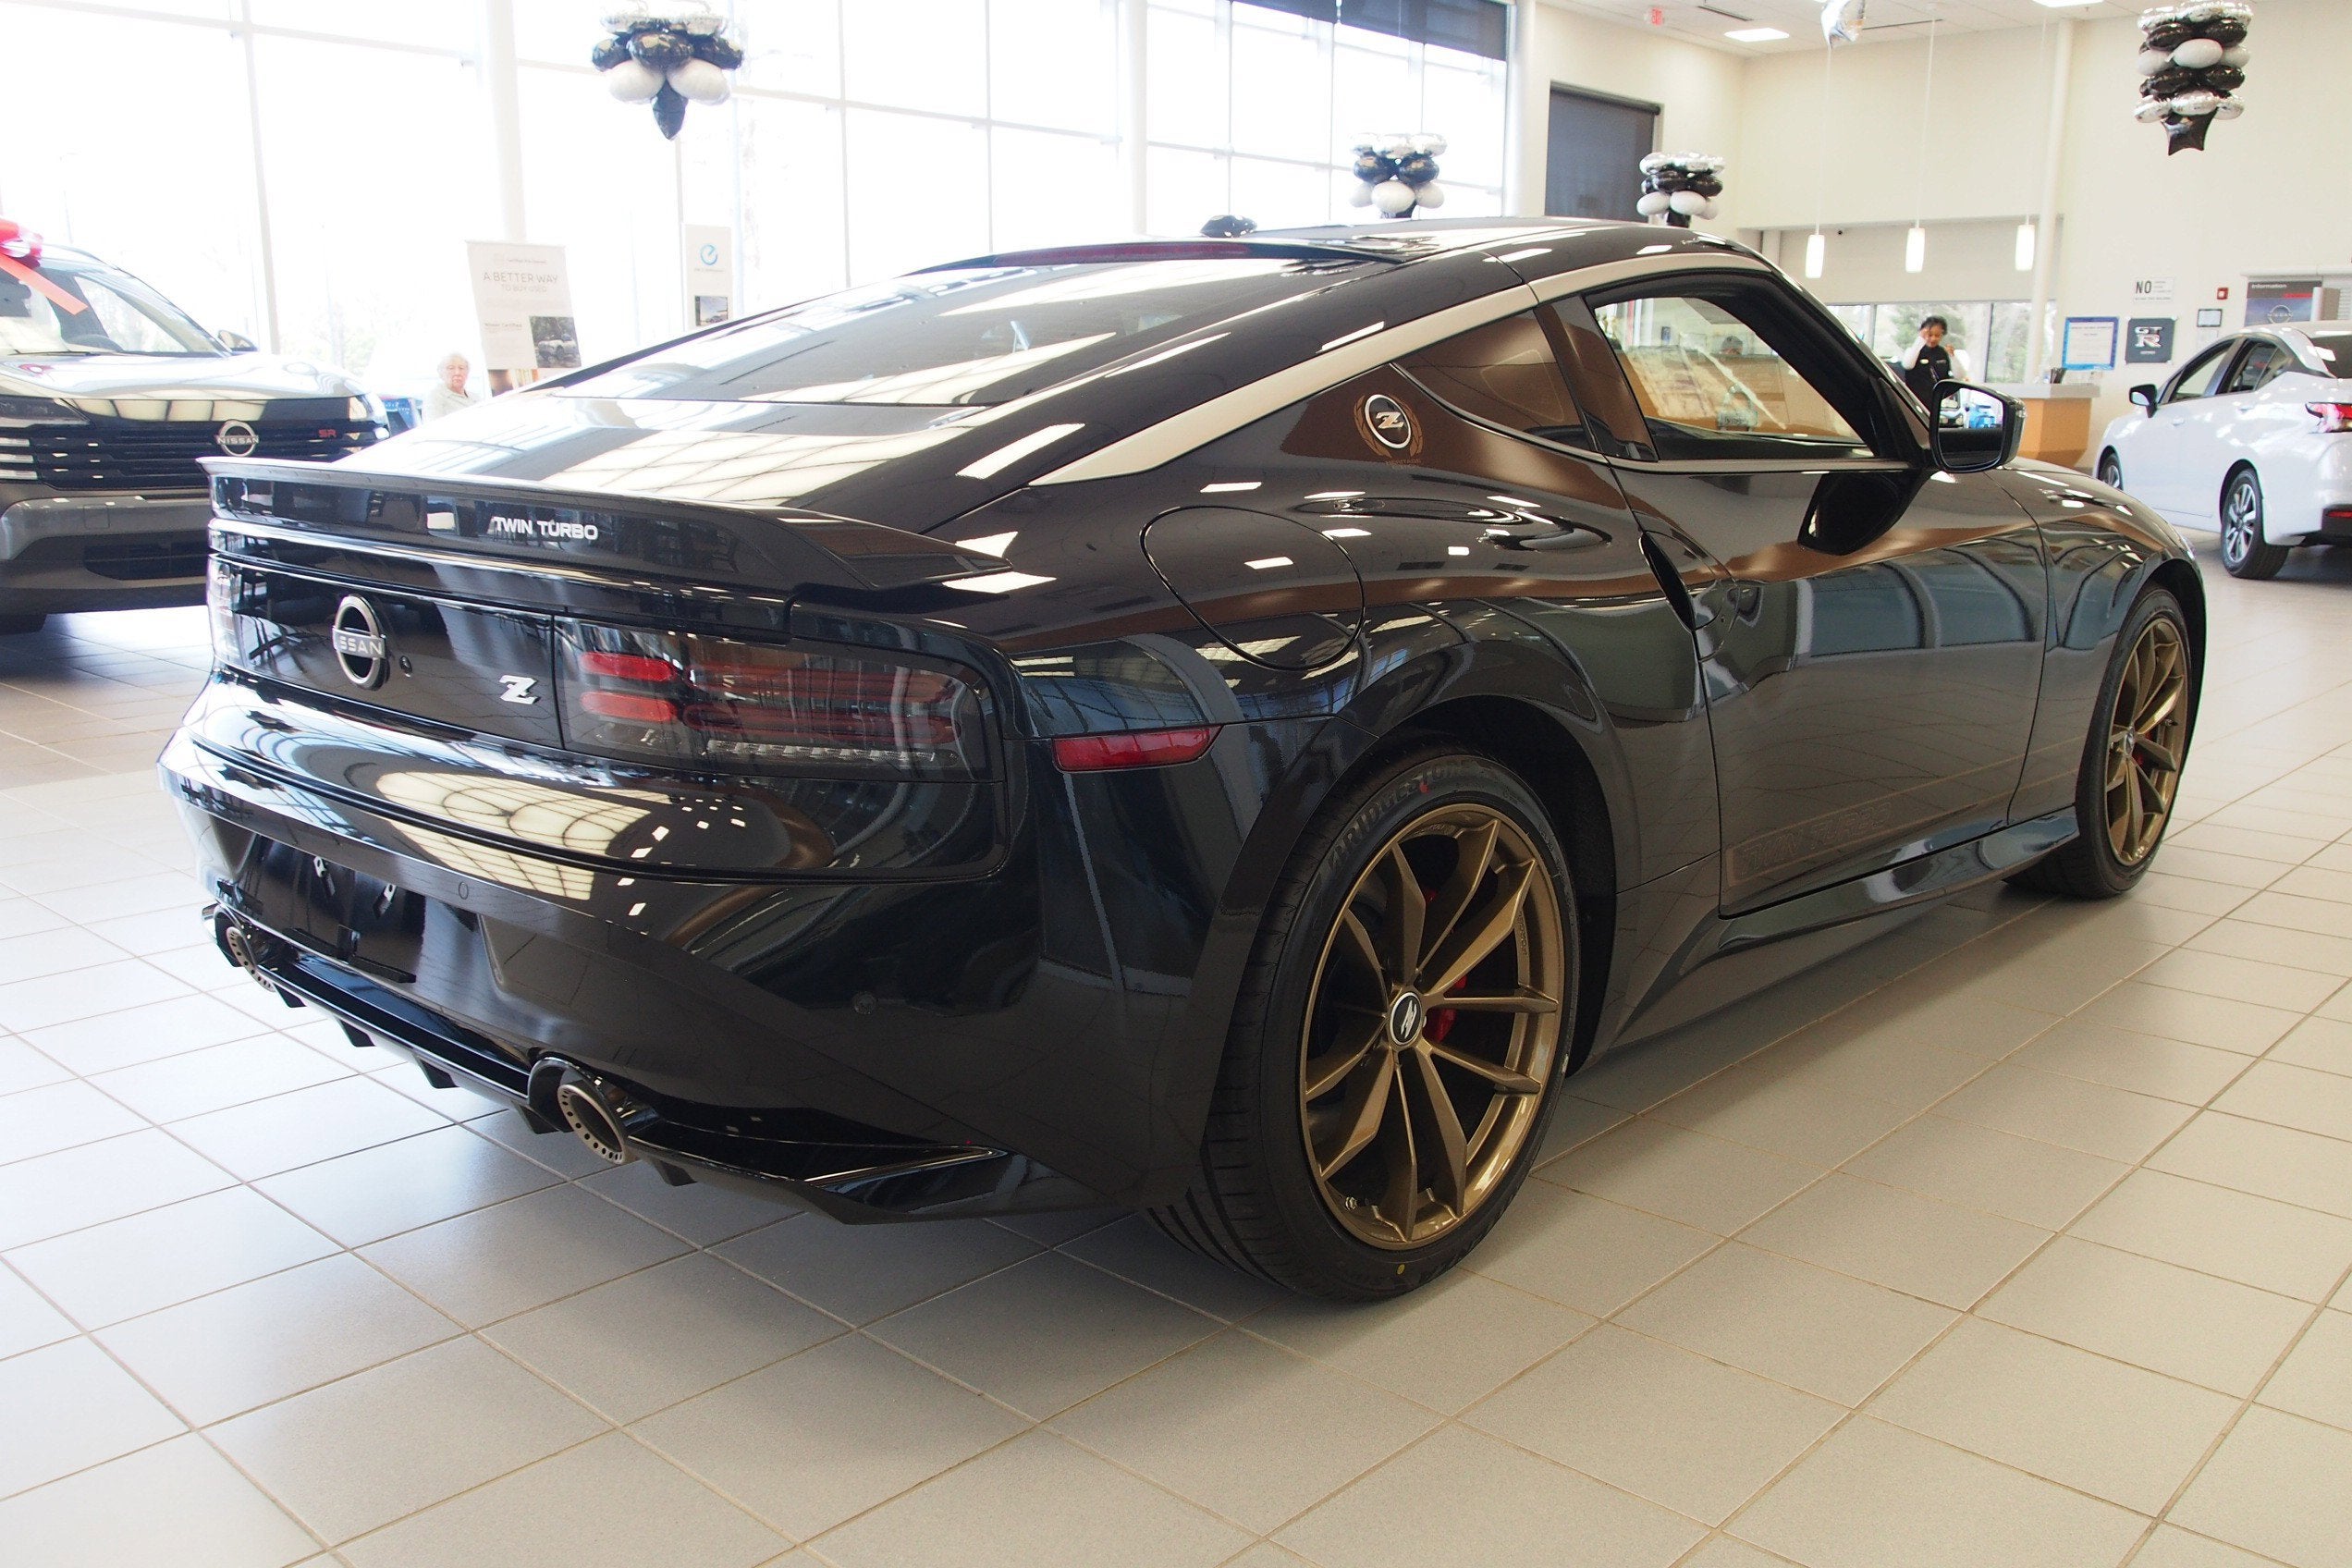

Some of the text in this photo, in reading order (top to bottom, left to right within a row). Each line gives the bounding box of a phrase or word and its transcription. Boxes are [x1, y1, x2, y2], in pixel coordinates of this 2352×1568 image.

[483, 272, 558, 284] A BETTER WAY
[2135, 280, 2152, 294] NO
[1375, 411, 1404, 429] Z
[217, 435, 260, 445] NISSAN
[318, 429, 337, 438] SR
[492, 516, 599, 540] TWIN TURBO
[499, 674, 541, 705] Z
